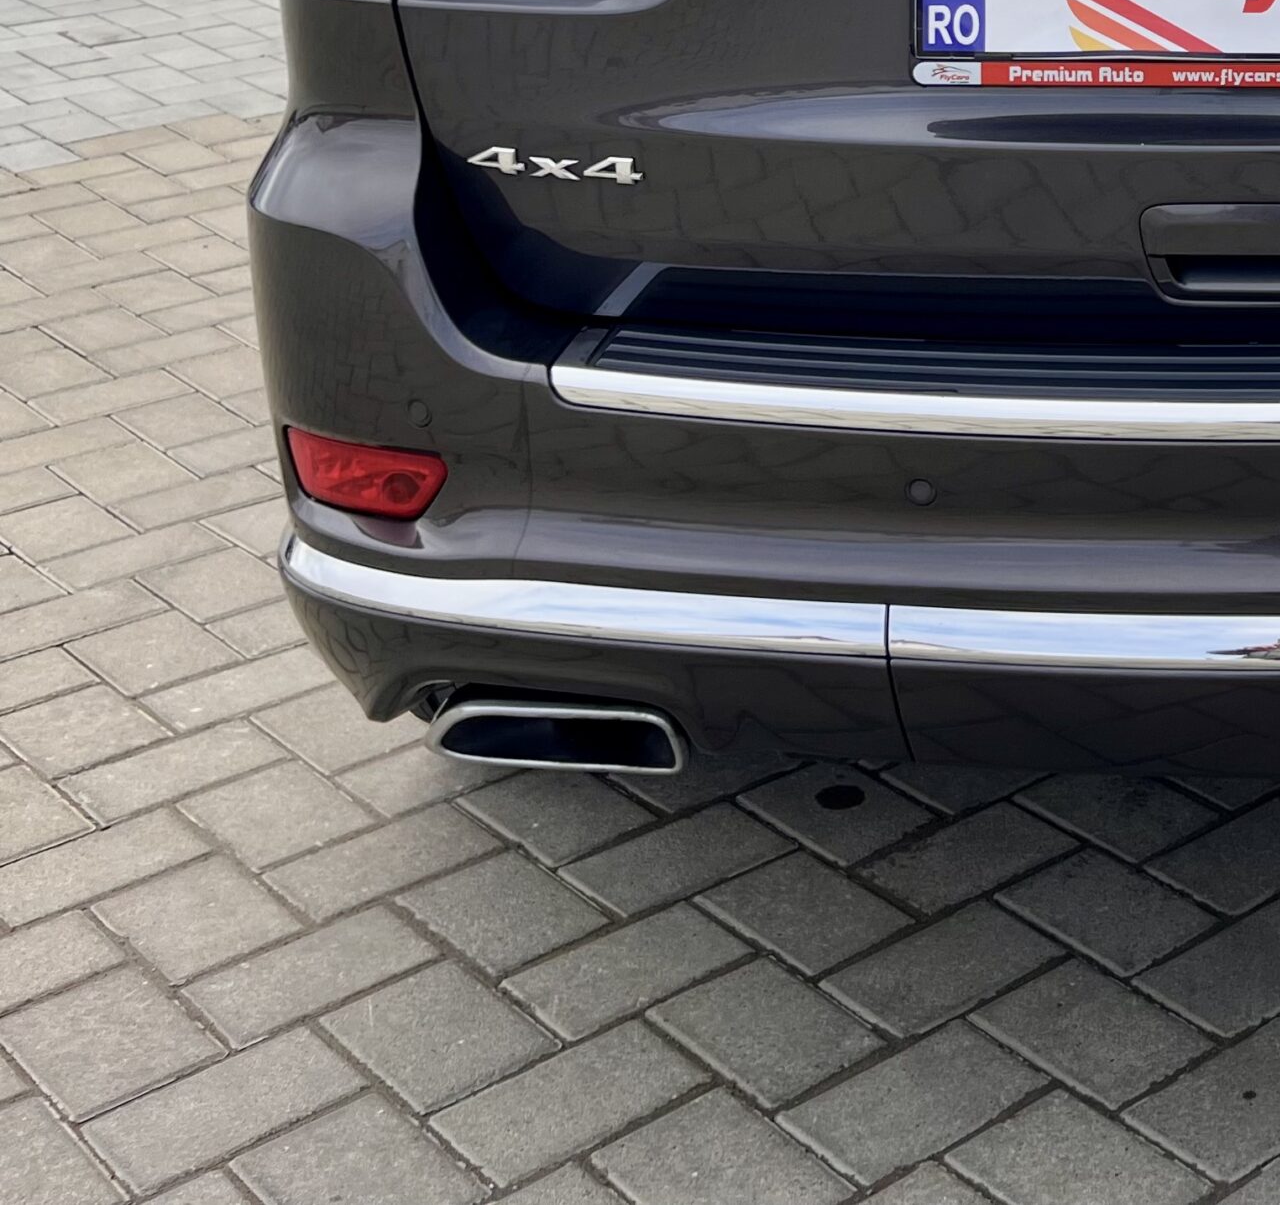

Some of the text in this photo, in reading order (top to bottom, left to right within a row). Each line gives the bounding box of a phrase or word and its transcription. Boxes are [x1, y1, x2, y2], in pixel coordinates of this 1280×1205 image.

[927, 4, 981, 45] RO
[1008, 66, 1145, 83] Premium Auto
[466, 146, 644, 185] 4x4
